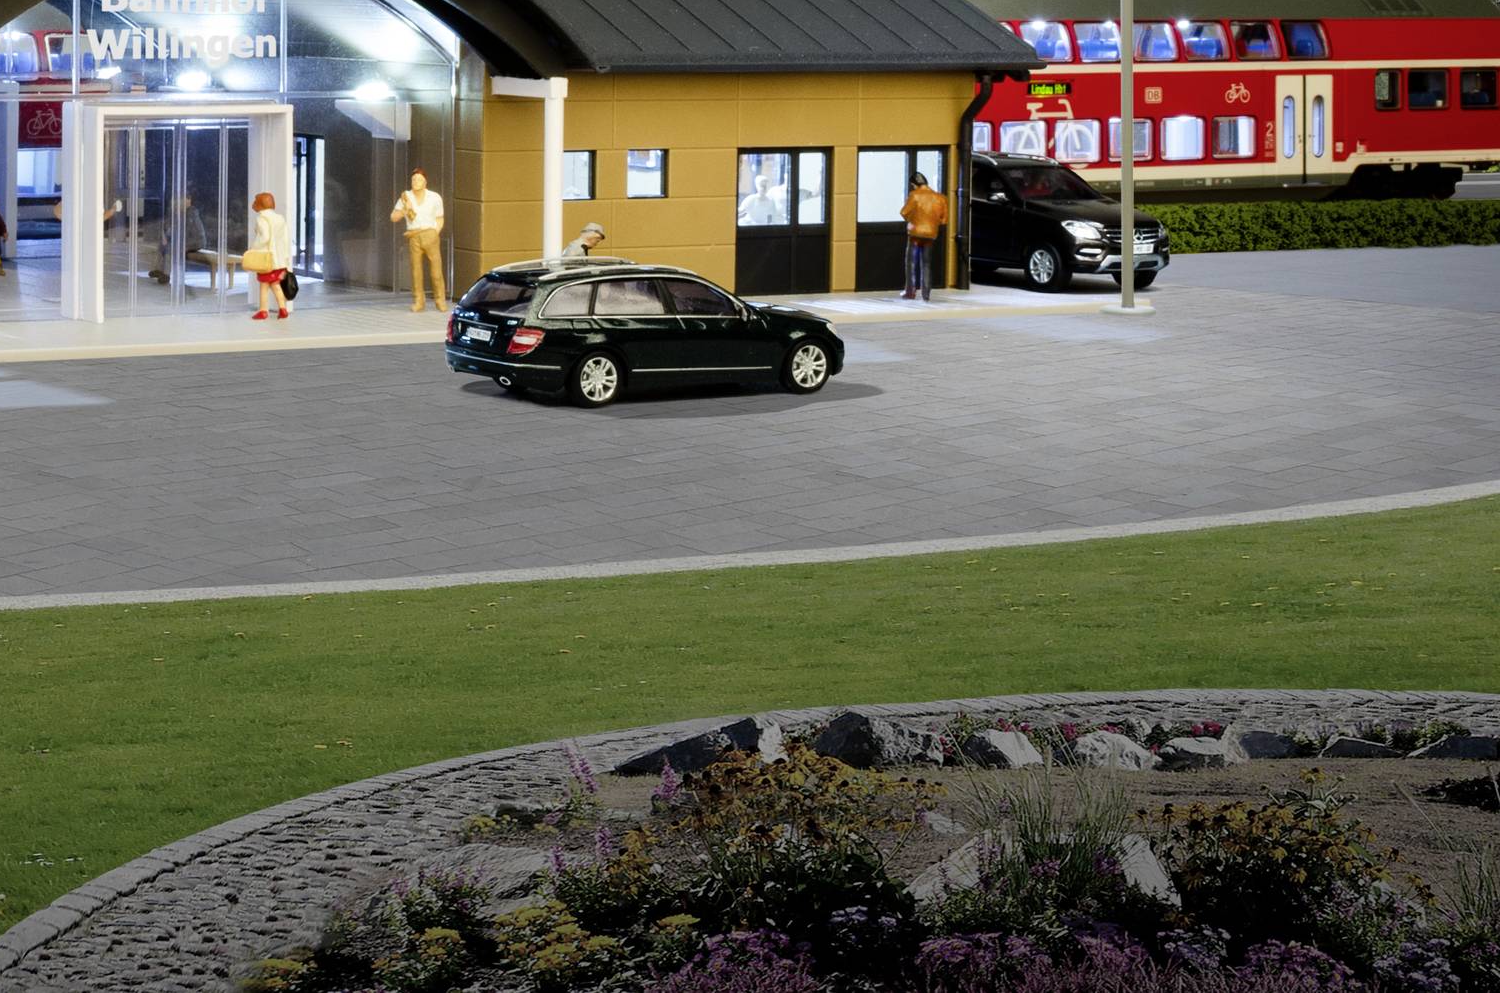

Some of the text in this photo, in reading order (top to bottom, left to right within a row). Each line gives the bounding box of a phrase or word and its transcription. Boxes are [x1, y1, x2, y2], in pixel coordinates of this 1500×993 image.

[86, 27, 277, 67] Willingen
[1031, 83, 1053, 94] Lindau
[1146, 90, 1161, 101] DB
[1265, 122, 1274, 137] 2
